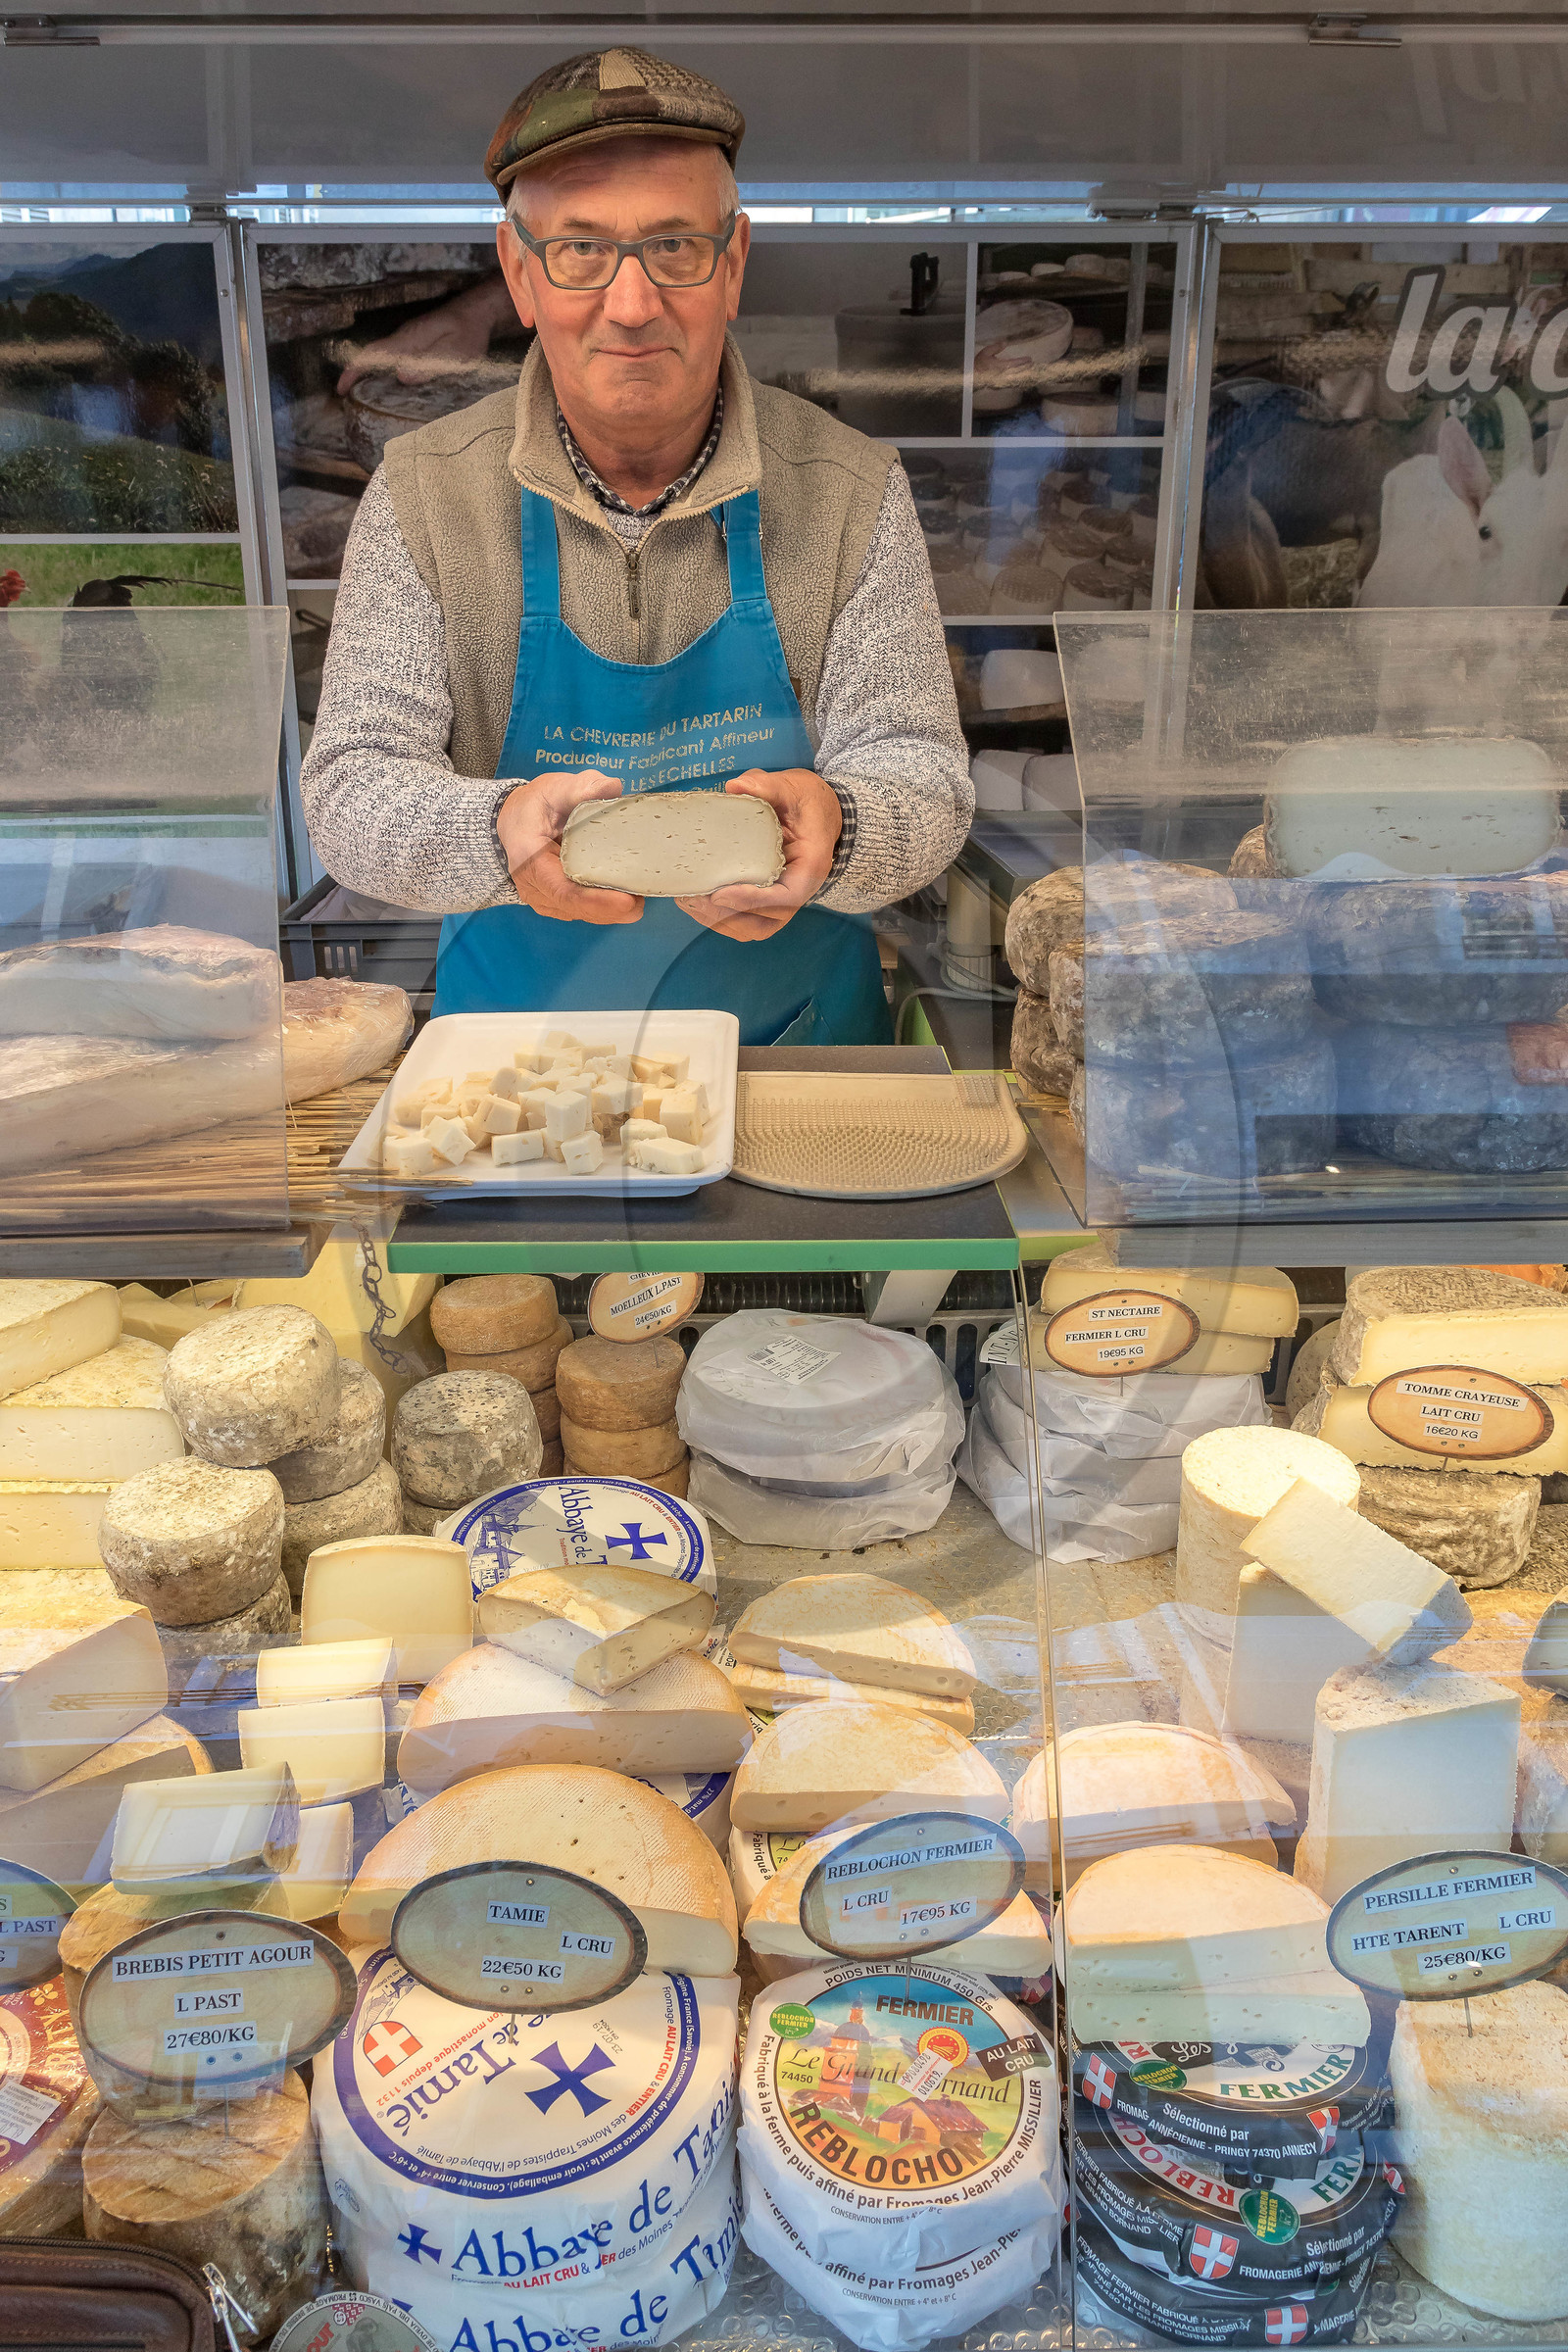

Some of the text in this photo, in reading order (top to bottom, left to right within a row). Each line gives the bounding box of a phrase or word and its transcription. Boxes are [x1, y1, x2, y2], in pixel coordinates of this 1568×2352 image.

[1386, 273, 1510, 392] la
[544, 703, 762, 748] LA CHEVRERIE DU TARTARIN
[535, 726, 775, 770] Producteur Fabricant Affineur
[630, 774, 657, 792] LES
[659, 755, 736, 784] ECHELLES
[611, 1287, 654, 1315] MOELLEUX
[1092, 1305, 1160, 1318] ST NECTAIRE
[635, 1305, 672, 1325] 24€50/KG
[1065, 1328, 1146, 1342] FERMIER L CRU
[1099, 1346, 1144, 1358] 19€95 KG
[1404, 1383, 1520, 1407] TOMME CRAYEUSE
[1421, 1406, 1481, 1421] LAIT CRU
[1426, 1425, 1478, 1439] 16€20 KG
[556, 1486, 594, 1544] Abbaye
[639, 1494, 664, 1514] LAIT CRU
[574, 1545, 593, 1559] de
[753, 1832, 770, 1874] Fabriqué
[827, 1838, 994, 1880] REBLOCHON FERMIER
[843, 1890, 889, 1911] L CRU
[1364, 1872, 1533, 1909] PERSILLE FERMIER
[13, 1920, 56, 1933] PAST
[490, 1904, 545, 1923] TAMIE
[902, 1900, 971, 1926] 17€95 KG
[1499, 1910, 1551, 1929] L CRU
[561, 1936, 612, 1954] L CRU
[1352, 1922, 1465, 1950] HTE TARENT
[115, 1945, 312, 1978] BREBIS PETIT AGOUR
[482, 1960, 562, 1978] 22€50 KG
[1423, 1946, 1506, 1969] 25€80/KG
[824, 1967, 863, 1987] POIDS
[865, 1965, 892, 1975] NET
[954, 1980, 975, 1998] 450
[975, 1995, 994, 2012] Grs
[176, 1992, 241, 2013] L PAST
[683, 1998, 692, 2021] France
[875, 1993, 974, 2027] FERMIER
[772, 2012, 814, 2024] REBLOCHON
[777, 2020, 808, 2029] FERMIER
[167, 2025, 255, 2050] 27€80/KG
[986, 2046, 1005, 2063] AU
[1007, 2037, 1036, 2056] LAIT
[376, 2024, 487, 2107] monastique depuis 1132
[783, 2048, 819, 2070] Le
[821, 2054, 901, 2084] Grand
[1004, 2054, 1035, 2073] CRU
[1171, 2042, 1212, 2063] Les
[386, 2022, 519, 2136] de Tamié
[416, 1986, 677, 2173] Fromage AU LAIT CRU ENTIER des Moines Trappistes de l'Abbaye de Tamié
[666, 2062, 689, 2101] consommer
[781, 2071, 814, 2084] 74450
[1132, 2065, 1178, 2083] REBLOCHON
[1144, 2073, 1179, 2084] FERMIER
[1220, 2054, 1353, 2100] FERMIER
[657, 2101, 668, 2112] de
[623, 2108, 661, 2148] préférence
[754, 2034, 1043, 2210] Fabriqué la ferme puis affiné par Jean-Pierre MISSILLIER
[1162, 2102, 1250, 2141] Sélectionné par
[603, 2140, 624, 2162] avant
[789, 2102, 991, 2185] REBLOCHON
[1149, 2119, 1318, 2160] ANNÉCIENNE PRINGY 74370 ANNECY
[432, 2173, 458, 2184] entre
[458, 2175, 507, 2192] Conserver
[1074, 2136, 1136, 2207] FERMIER FABRIQUÉ
[629, 2179, 673, 2234] de
[1084, 2167, 1136, 2221] LES FROMAGES
[1084, 2180, 1108, 2212] GRAND
[1108, 2210, 1152, 2235] BORNAND
[830, 2205, 905, 2226] CONSERVATION ENTRE
[1256, 2190, 1270, 2237] REBLOCHON
[1267, 2198, 1279, 2233] FERMIER
[1353, 2227, 1366, 2245] par
[523, 2273, 551, 2288] LAIT
[554, 2264, 579, 2284] CRU
[617, 2245, 637, 2259] des
[638, 2220, 674, 2252] Moines
[825, 2261, 970, 2290] affiné par Fromages
[1076, 2234, 1200, 2325] FROMAGE FERMIER FABRIQUÉ
[1239, 2265, 1303, 2280] FROMAGERIE
[842, 2287, 916, 2307] CONSERVATION ENTRE
[1112, 2284, 1132, 2301] PAR
[1133, 2298, 1152, 2315] LES
[1152, 2313, 1209, 2334] FROMAGES
[619, 2288, 669, 2337] de
[1093, 2279, 1227, 2343] 74450 LE GRAND BORNAND
